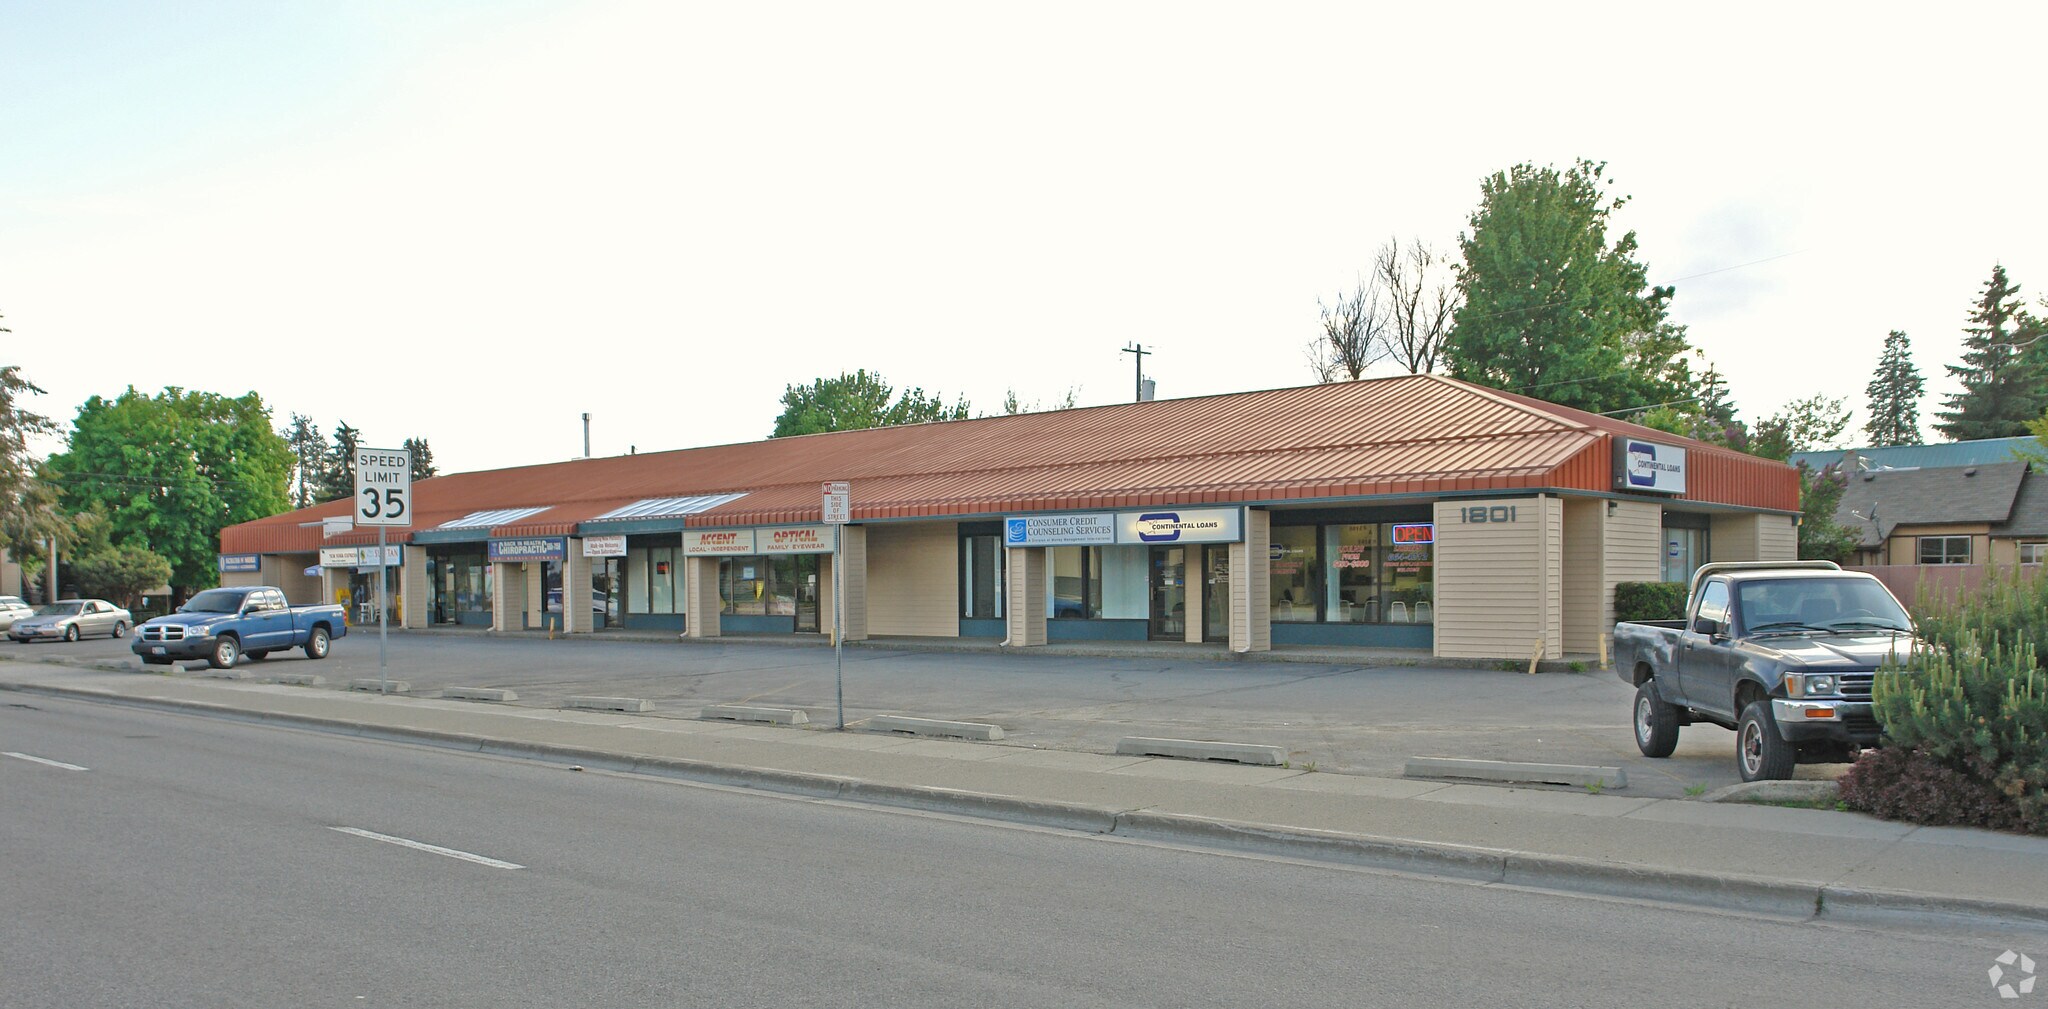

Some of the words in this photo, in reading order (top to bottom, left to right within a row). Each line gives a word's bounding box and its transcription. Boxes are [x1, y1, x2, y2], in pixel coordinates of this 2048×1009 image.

[360, 455, 405, 467] SPEED
[1638, 459, 1666, 471] CONTINENTAL
[1667, 463, 1680, 473] LOANS
[365, 472, 399, 483] LIMIT
[361, 487, 404, 518] 35
[1461, 505, 1516, 523] 1801
[1027, 518, 1068, 527] CONSUMER
[1069, 516, 1098, 526] CREDIT
[1151, 523, 1195, 531] CONTINENTAL
[1196, 521, 1218, 529] LOANS
[700, 533, 737, 545] ACCENT
[773, 530, 818, 543] OPTICAL
[1027, 527, 1074, 537] COUNSELING
[1075, 525, 1111, 535] SERVICES
[1395, 527, 1433, 542] OPEN
[498, 540, 547, 555] CHIROPRACTIC
